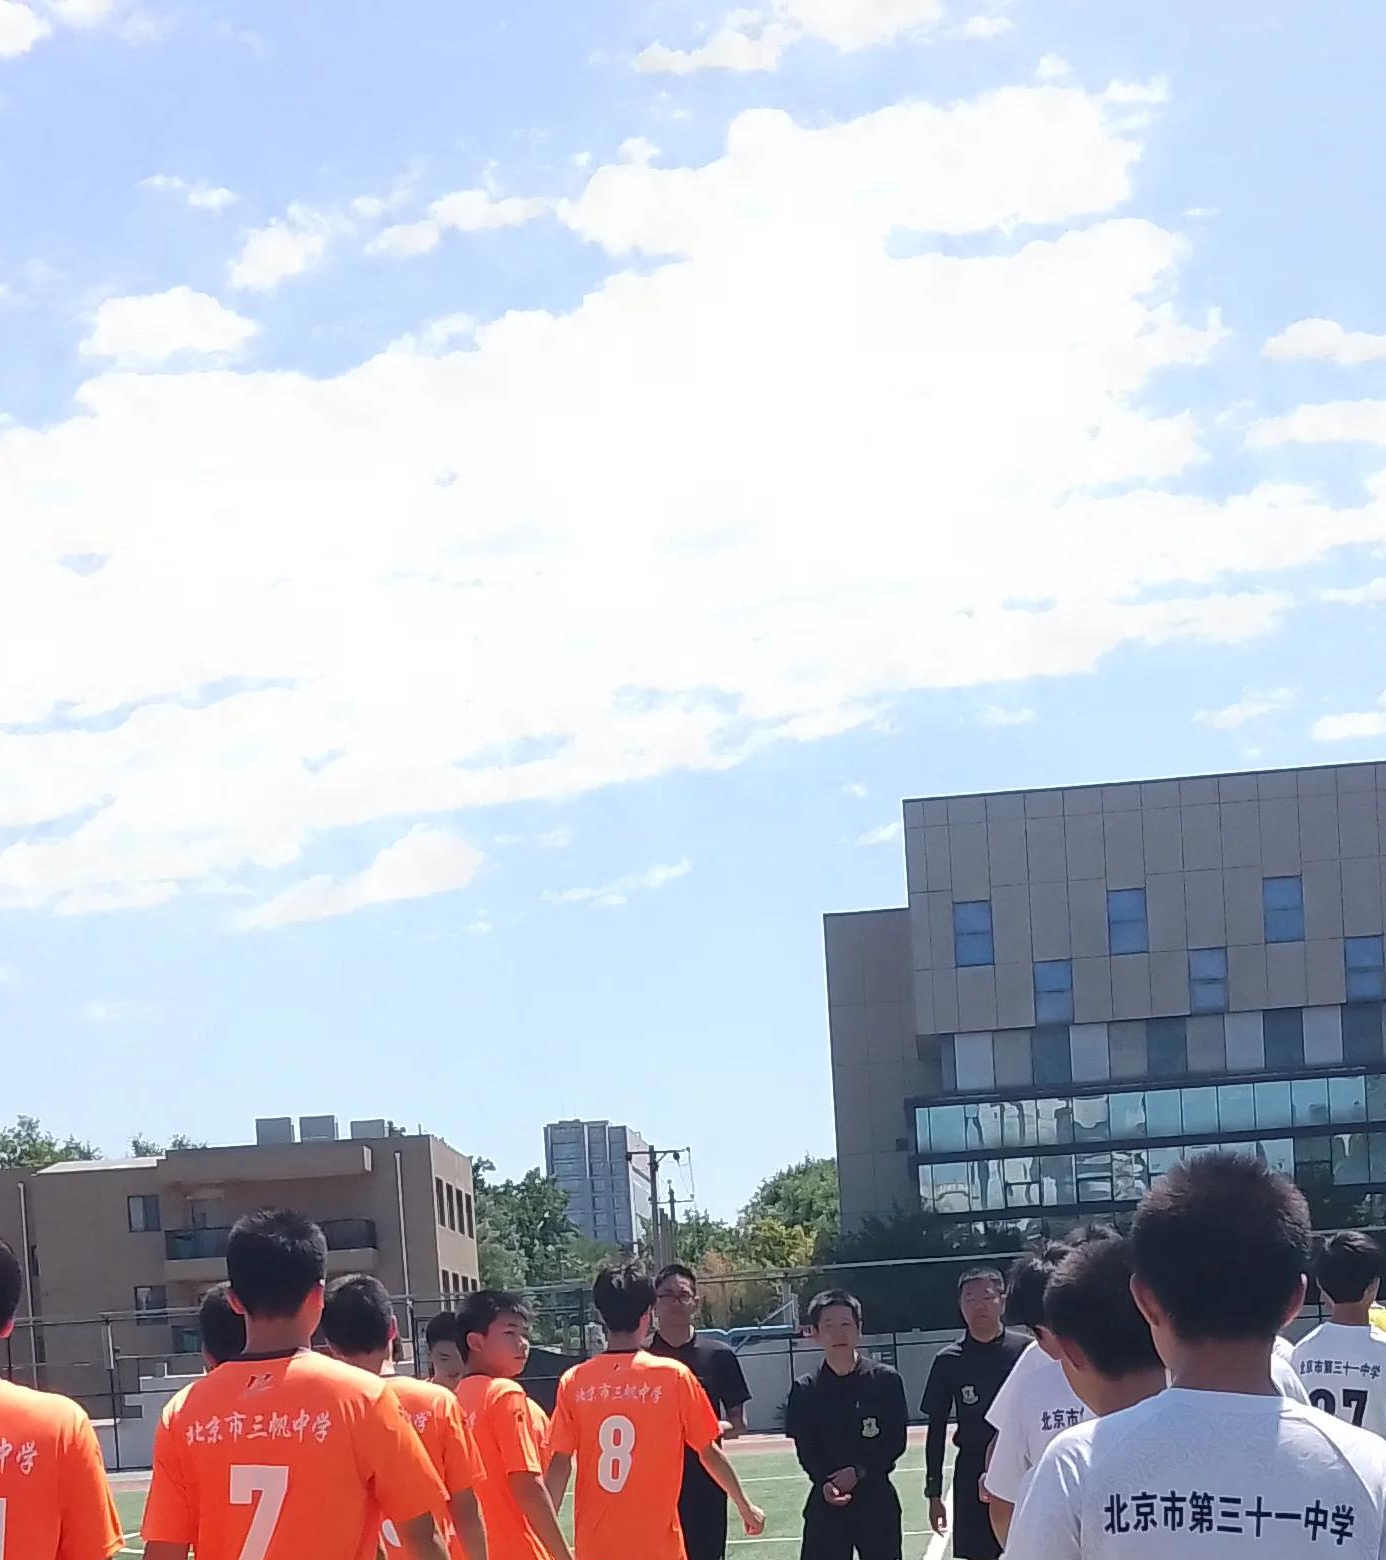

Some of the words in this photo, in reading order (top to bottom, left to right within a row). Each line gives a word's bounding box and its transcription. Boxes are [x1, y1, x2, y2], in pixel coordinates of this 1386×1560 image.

[185, 1408, 332, 1446] 北京市三帆中学
[597, 1414, 635, 1493] 8
[1104, 1490, 1355, 1546] 北京市第三十一中学
